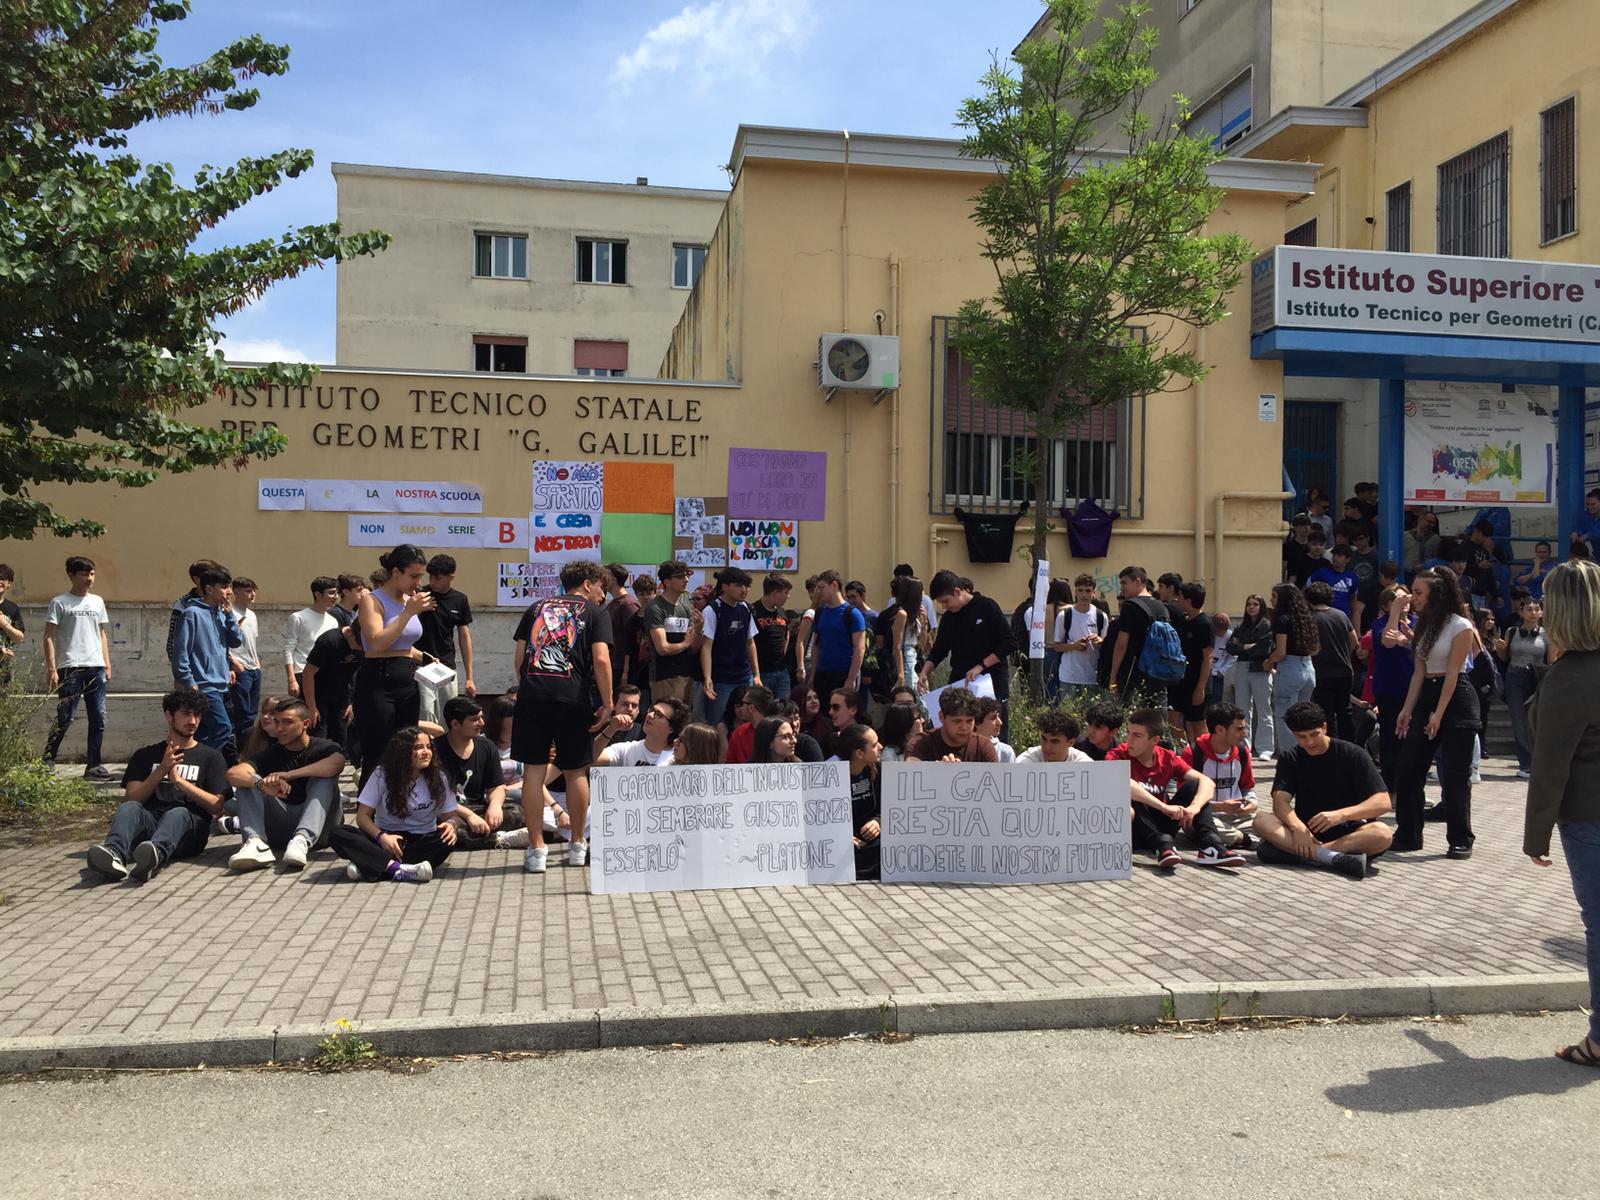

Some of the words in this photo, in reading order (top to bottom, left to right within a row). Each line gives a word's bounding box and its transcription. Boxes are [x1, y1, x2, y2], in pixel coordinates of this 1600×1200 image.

[1292, 261, 1415, 293] Istituto
[1426, 269, 1584, 303] Superiore
[1287, 300, 1359, 318] Istituto
[1366, 304, 1443, 322] Tecnico
[1450, 311, 1480, 326] per
[1486, 310, 1572, 329] Geometri
[230, 384, 380, 411] ISTITUTO
[409, 390, 547, 417] TECNICO
[575, 396, 702, 422] STATALE
[313, 423, 480, 450] GEOMETRI
[1452, 457, 1478, 469] OPEN
[261, 487, 305, 498] QUESTA
[366, 489, 379, 499] LA
[395, 489, 438, 499] NOSTRA
[439, 490, 481, 501] SCUOLA
[534, 483, 602, 510] SFRATTO
[360, 524, 385, 534] NON
[400, 525, 436, 535] SIAMO
[448, 525, 476, 535] SERIE
[498, 521, 516, 544] B
[556, 513, 592, 528] CASA
[730, 521, 756, 536] NOI
[758, 521, 793, 536] NON
[731, 548, 741, 560] IL
[743, 548, 773, 560] POSTO
[744, 535, 796, 548] LASCIAMO
[500, 577, 521, 587] NON
[617, 768, 707, 802] CAPOLAVORO
[897, 771, 937, 801] IL
[951, 770, 1089, 803] GALILEI
[625, 808, 640, 834] DI
[647, 802, 734, 834] SEMBRARE
[743, 800, 799, 827] GIUSTA
[803, 797, 851, 826] SENZA
[888, 806, 990, 837] RESTA
[1001, 807, 1060, 838] QUI,
[1067, 806, 1124, 836] NON
[881, 844, 966, 876] UCCIDETE
[971, 844, 986, 872] IL
[991, 845, 1060, 877] NOSTRO
[1066, 842, 1132, 874] FUTURO
